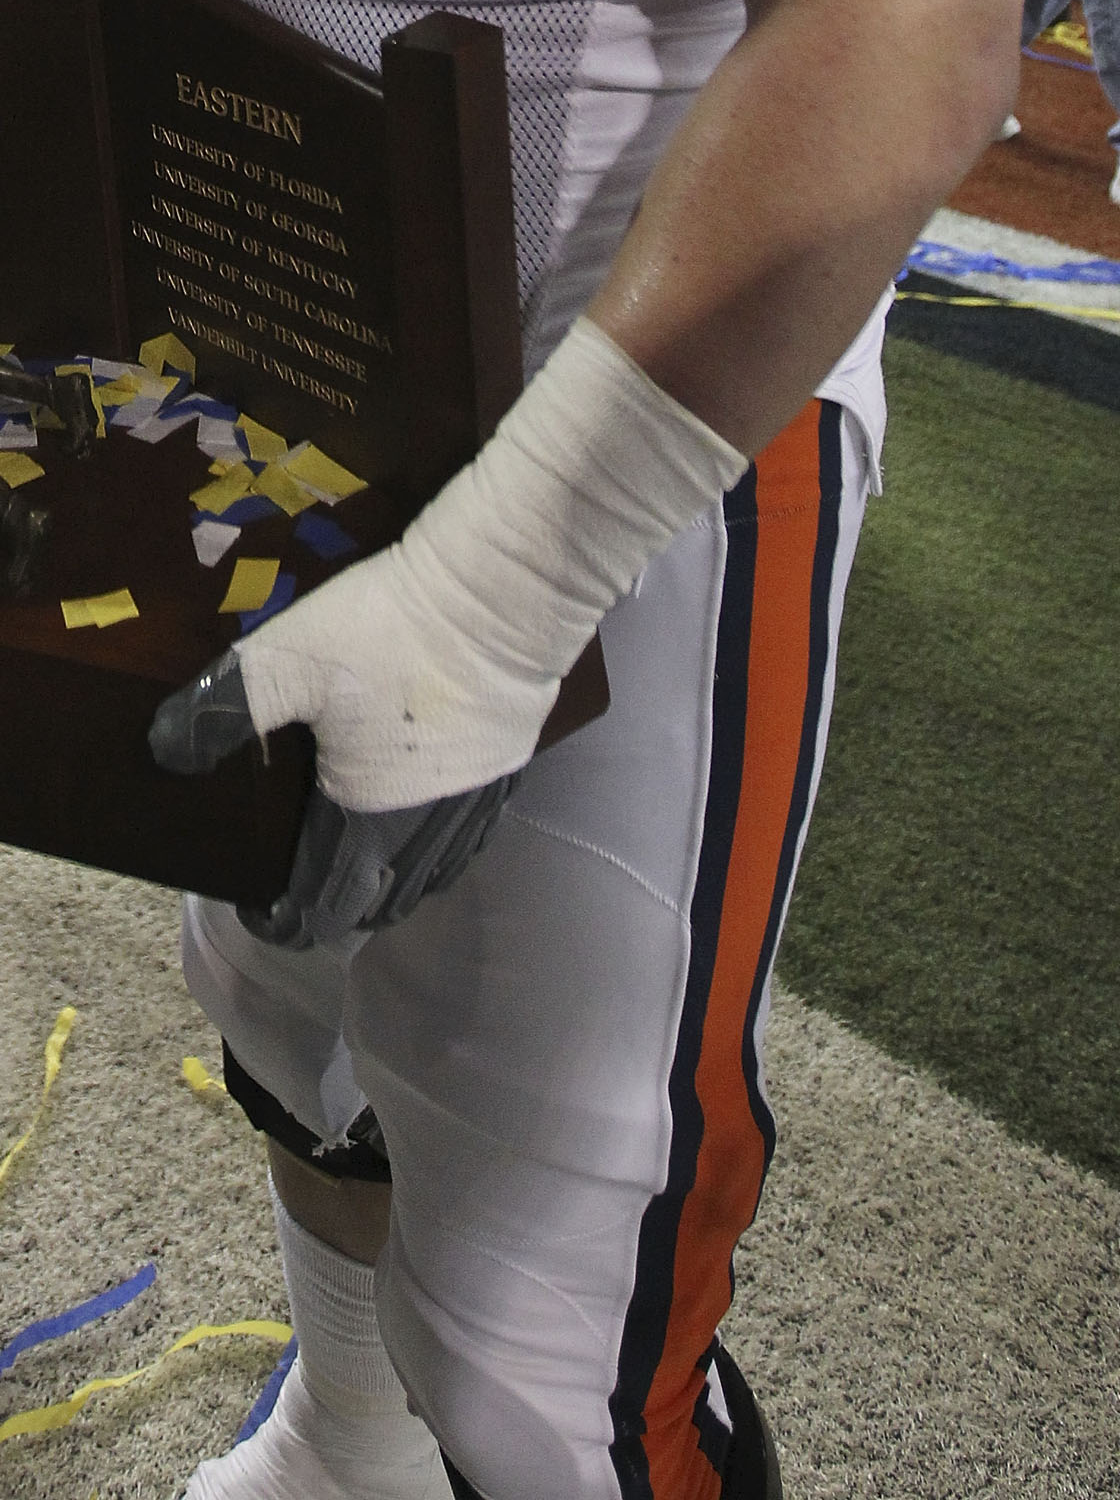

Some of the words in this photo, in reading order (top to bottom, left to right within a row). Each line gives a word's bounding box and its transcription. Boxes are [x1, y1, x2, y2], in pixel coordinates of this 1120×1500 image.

[175, 71, 302, 147] EASTERN
[151, 123, 239, 173] UNIVERSITY
[243, 161, 266, 183] OF
[268, 170, 344, 215] FLORIDA
[153, 159, 241, 211] UNIVERSITY
[245, 200, 269, 220] OF
[271, 209, 349, 258] GEORGIA
[130, 219, 214, 272] UNIVERSITY
[219, 262, 241, 283] OF
[243, 274, 300, 313] SOUTH
[304, 300, 393, 355] CAROLINA
[151, 194, 237, 246] UNIVERSITY
[241, 236, 264, 257] OF
[267, 245, 359, 300] KENTUCKY
[155, 267, 242, 321] UNIVERSITY
[246, 311, 269, 333] OF
[271, 322, 368, 384] TENNESSEE
[167, 305, 258, 365] VANDERBILT
[260, 353, 359, 416] UNIVERSITY
